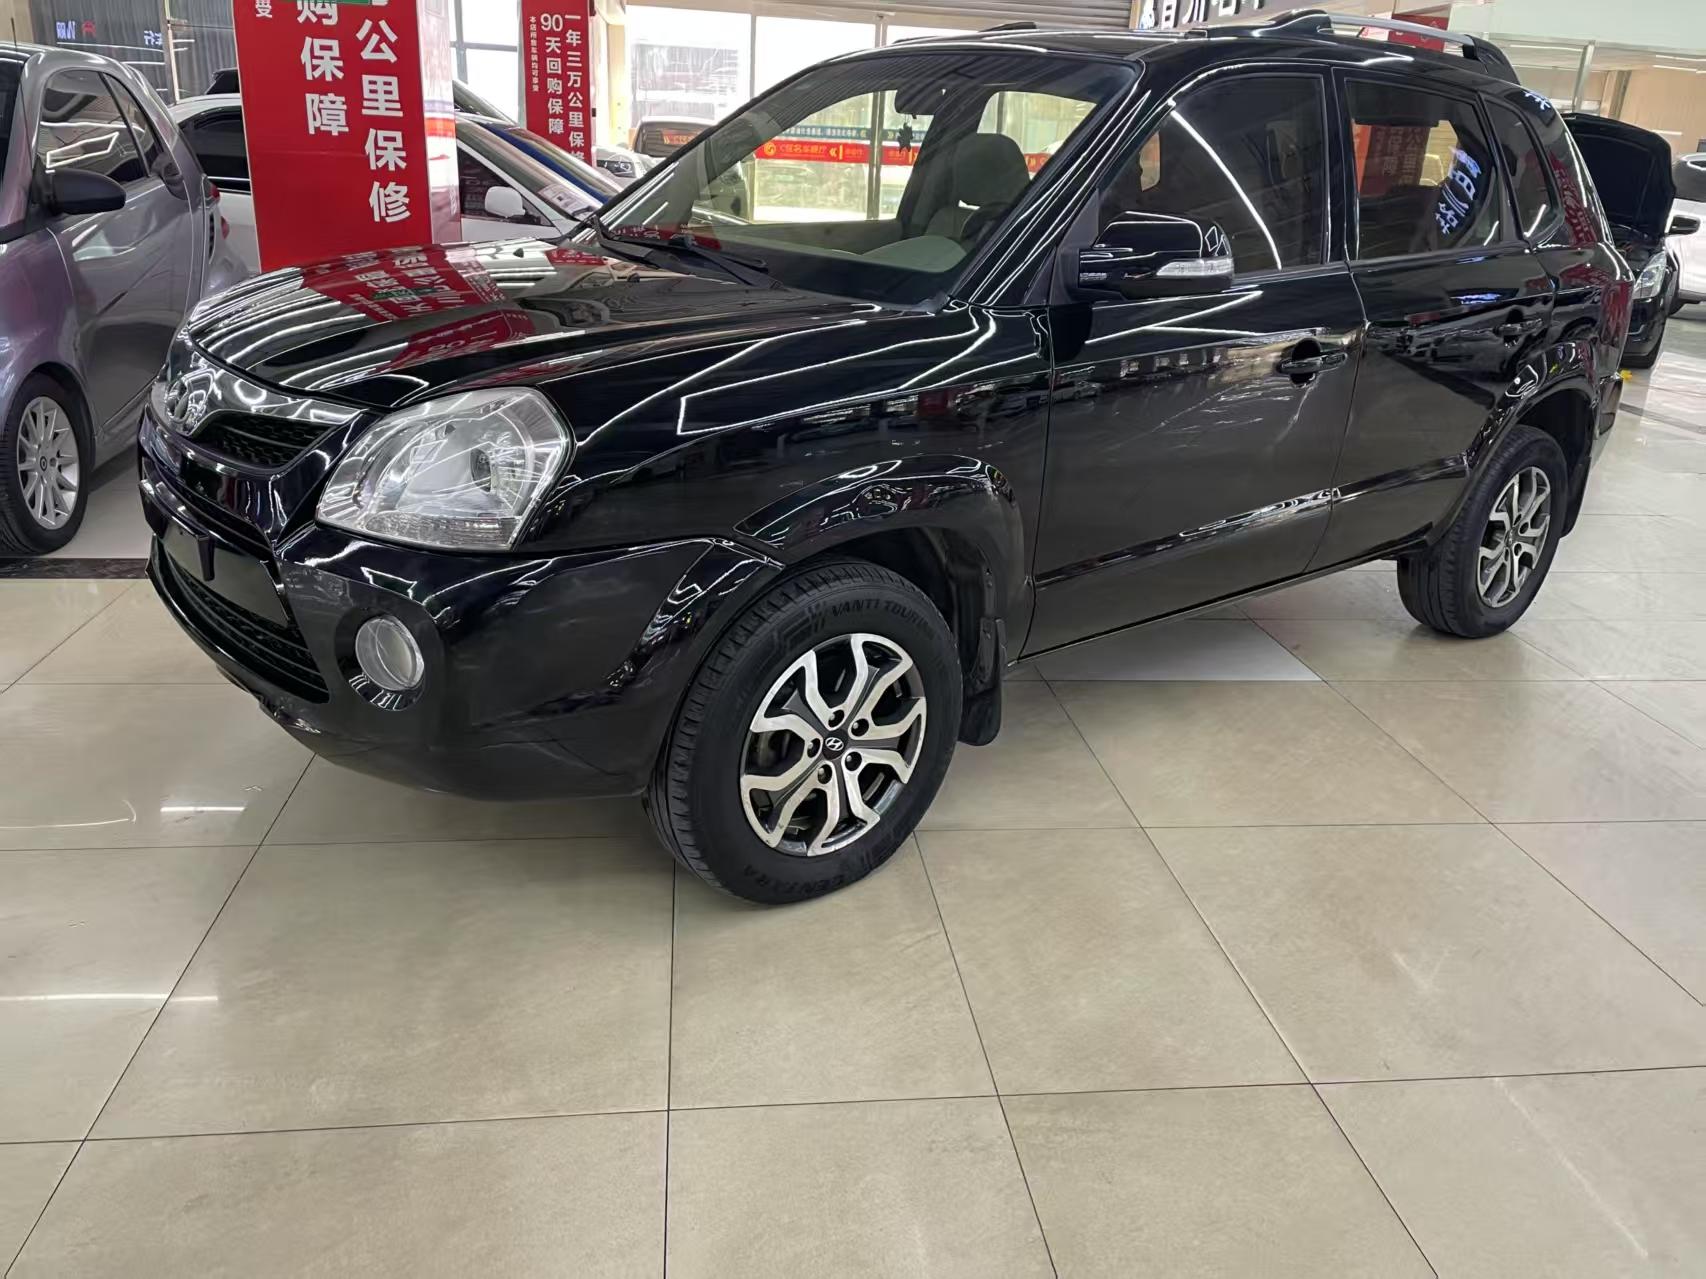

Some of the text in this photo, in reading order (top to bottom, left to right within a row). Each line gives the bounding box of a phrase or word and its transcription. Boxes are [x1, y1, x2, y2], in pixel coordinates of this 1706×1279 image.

[355, 0, 412, 223] 公里保修
[540, 13, 565, 135] 90天回购保障
